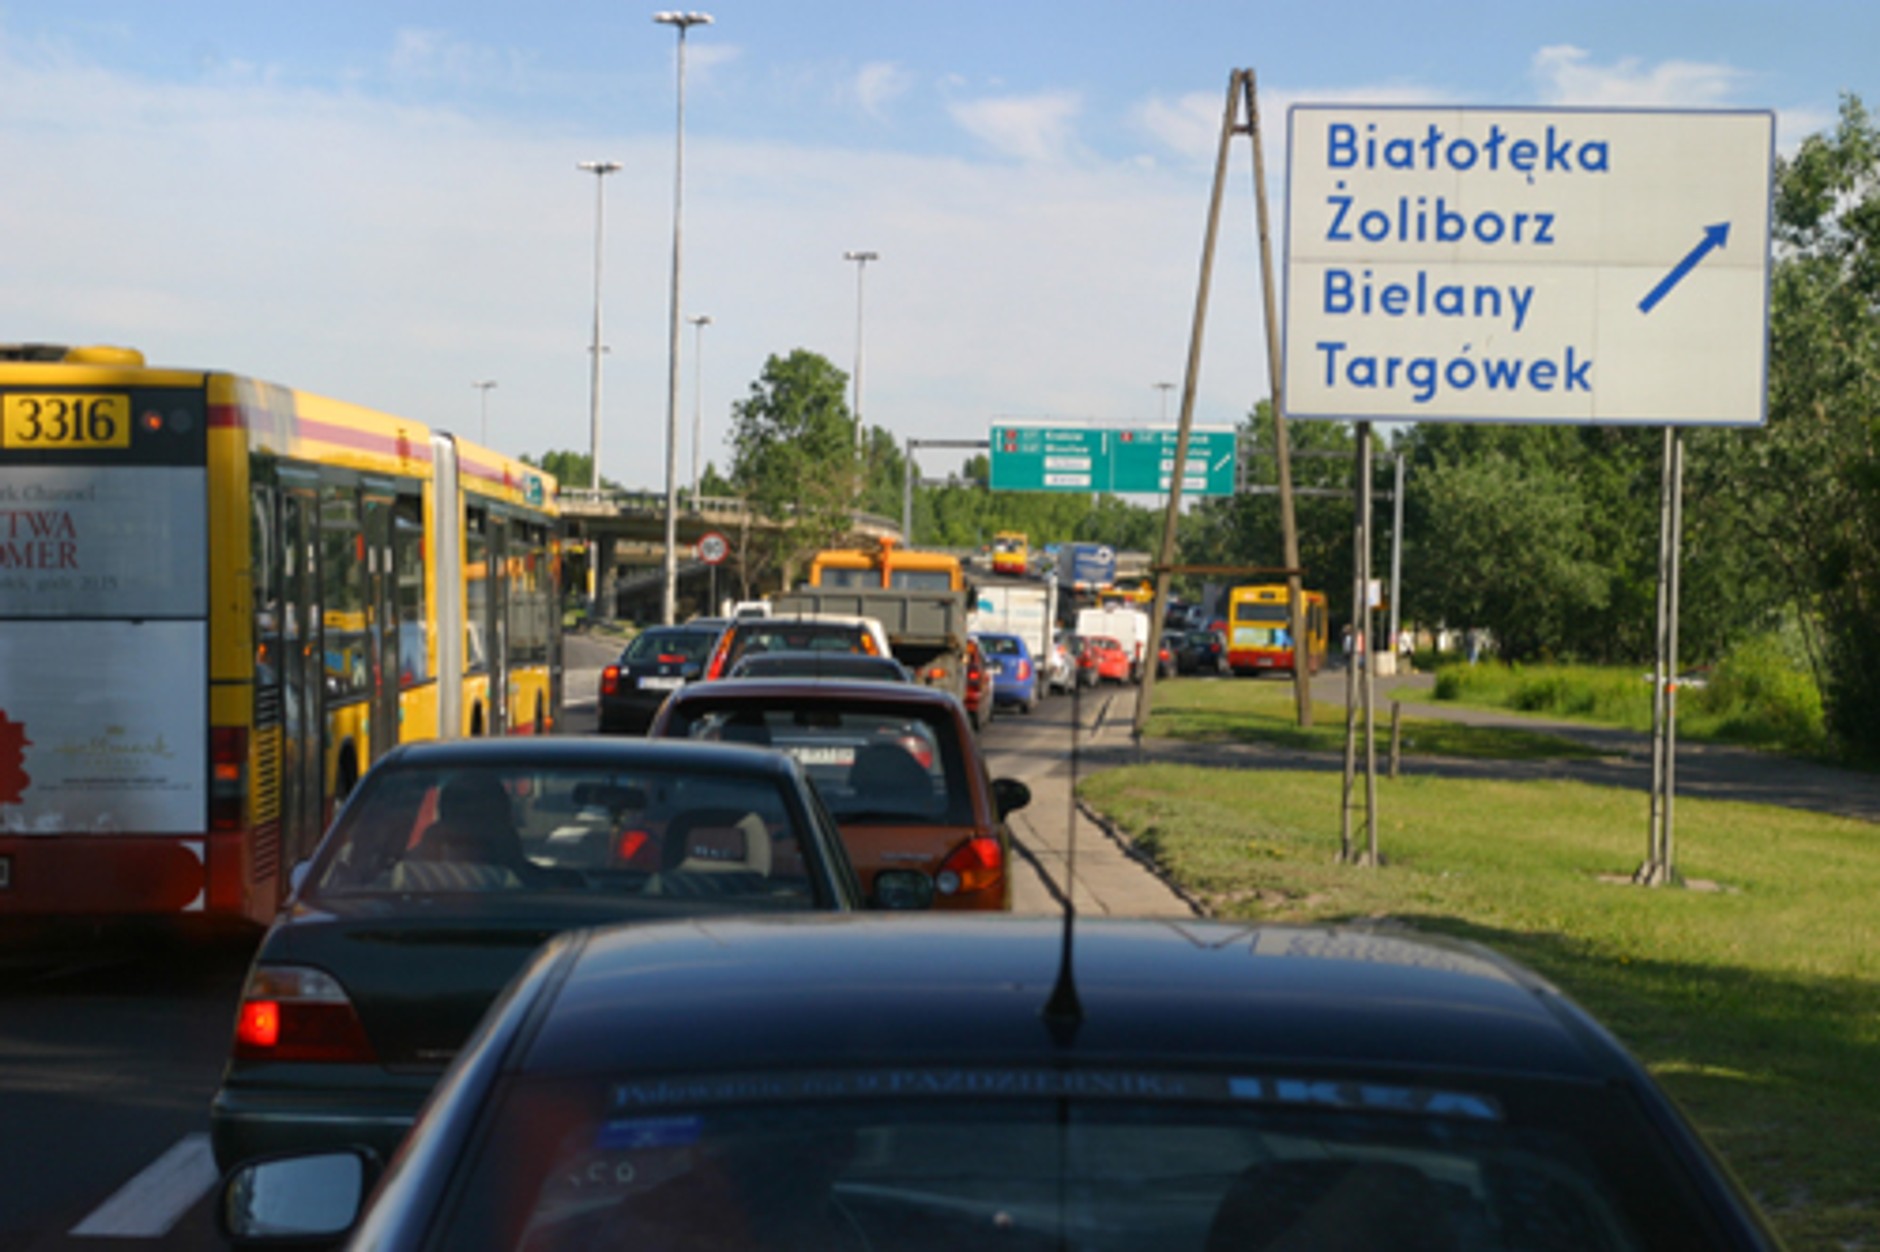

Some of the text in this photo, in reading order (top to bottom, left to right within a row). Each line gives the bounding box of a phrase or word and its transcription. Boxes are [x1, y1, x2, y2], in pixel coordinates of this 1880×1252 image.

[1327, 123, 1609, 185] Białołęka
[1326, 180, 1555, 244] Żoliborz
[1323, 269, 1534, 331] Bielany
[1316, 342, 1593, 402] Targówek
[16, 397, 117, 441] 3316
[0, 541, 79, 569] MER
